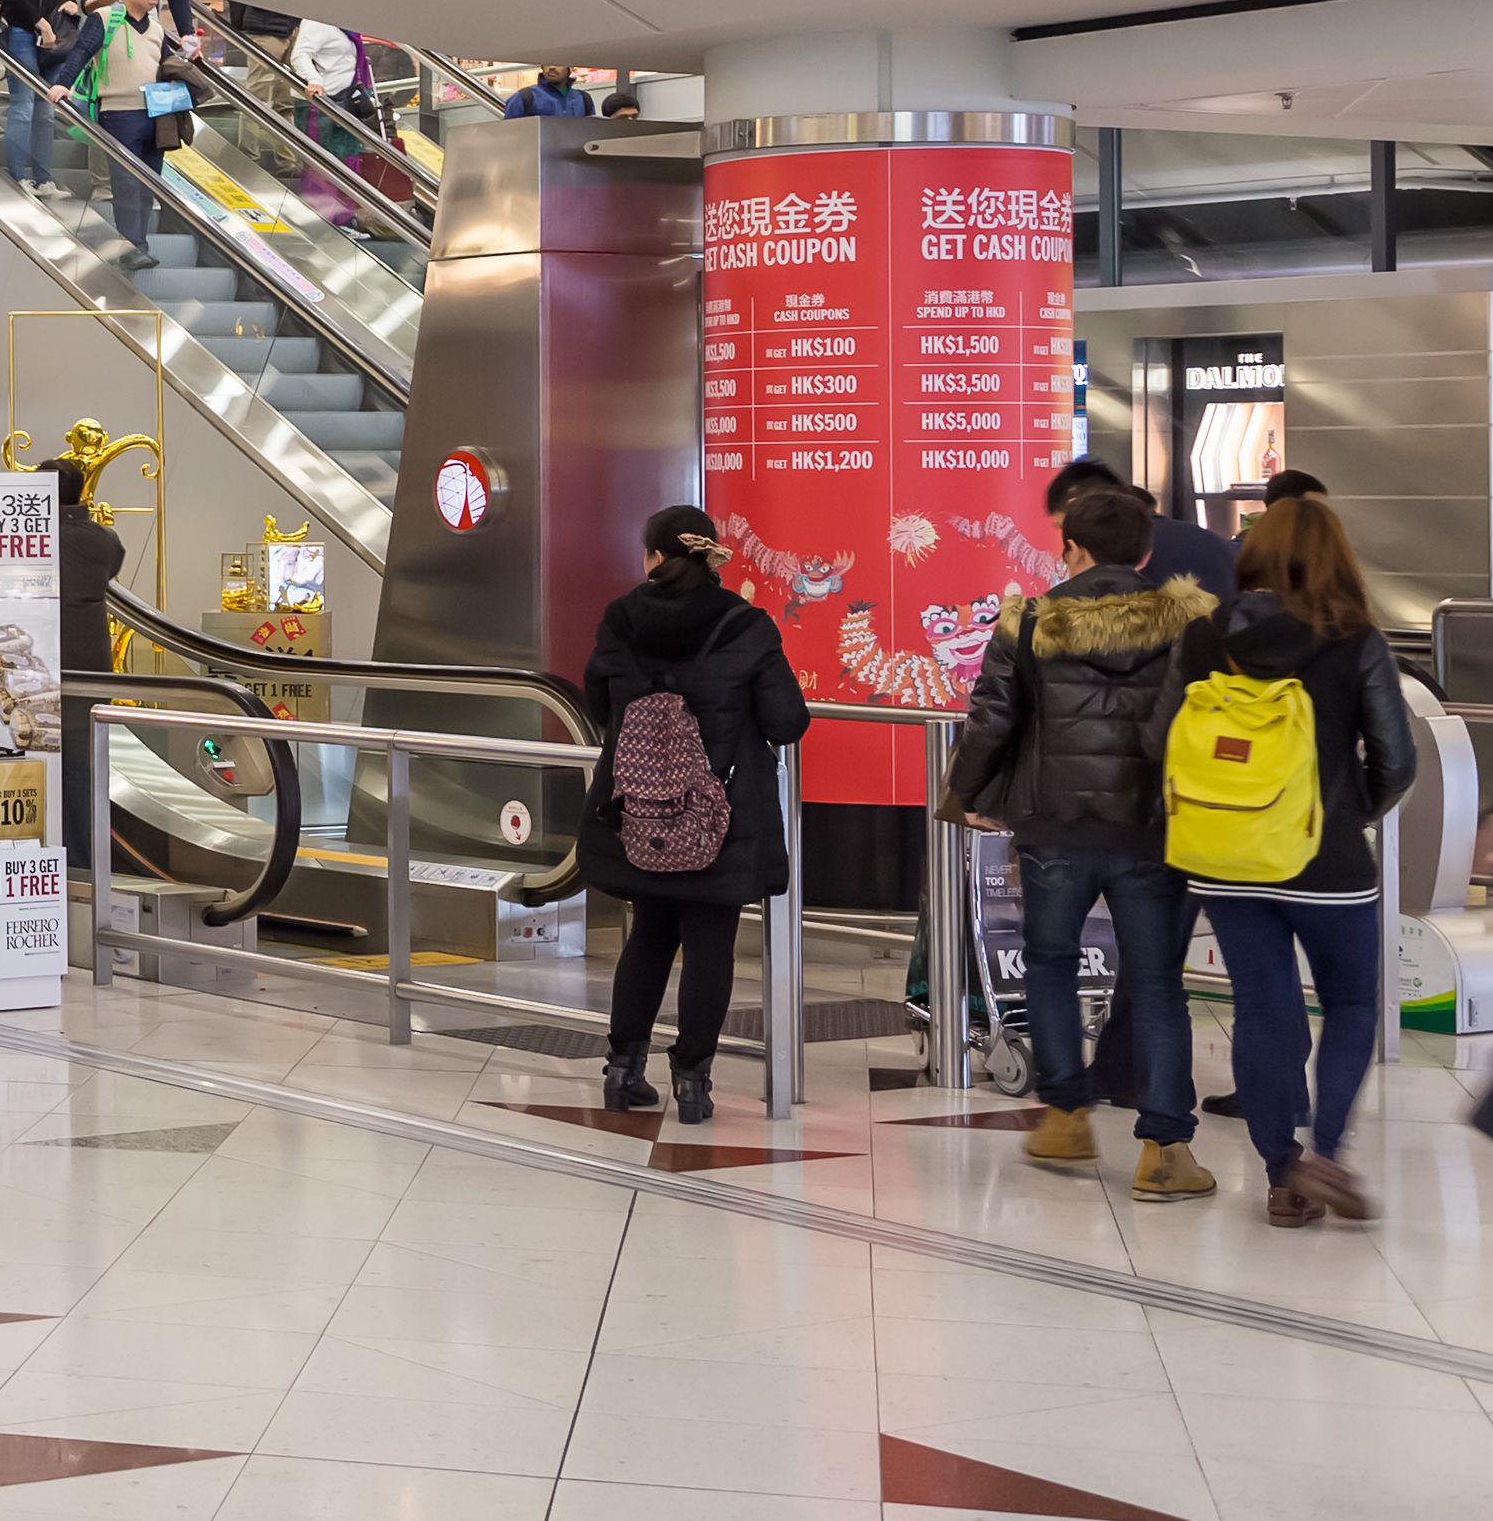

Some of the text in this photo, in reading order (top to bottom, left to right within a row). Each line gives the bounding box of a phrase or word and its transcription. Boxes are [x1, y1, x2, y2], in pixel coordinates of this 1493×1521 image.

[705, 190, 858, 242] 送您現金券
[720, 243, 758, 270] CASH
[763, 236, 856, 266] COUPON
[921, 234, 966, 260] GET
[972, 234, 1026, 261] CASH
[785, 293, 826, 308] 現金券
[773, 308, 850, 322] CASH COUPONS
[916, 307, 1005, 318] SPEND UP TO HKD
[791, 337, 856, 358] HK$100
[921, 335, 999, 357] HK$1,500
[1237, 353, 1263, 364] THE
[791, 374, 857, 395] HK$300
[921, 373, 1001, 395] HK$3,500
[791, 412, 857, 433] HK$500
[921, 411, 1001, 432] HK$5,000
[792, 449, 873, 473] HK$1,200
[922, 449, 1009, 472] HK$10,000
[10, 519, 19, 533] 3
[24, 518, 51, 533] GET
[245, 682, 312, 698] GET 1 FREE
[22, 788, 38, 798] SETS
[5, 858, 59, 875] BUY 3 GET
[985, 864, 1013, 875] NEVER
[6, 874, 60, 898] 1 FREE
[985, 877, 1005, 886] TOO
[985, 887, 1023, 898] TIMELESS
[6, 918, 59, 935] FERRERO
[6, 933, 60, 950] ROCHER
